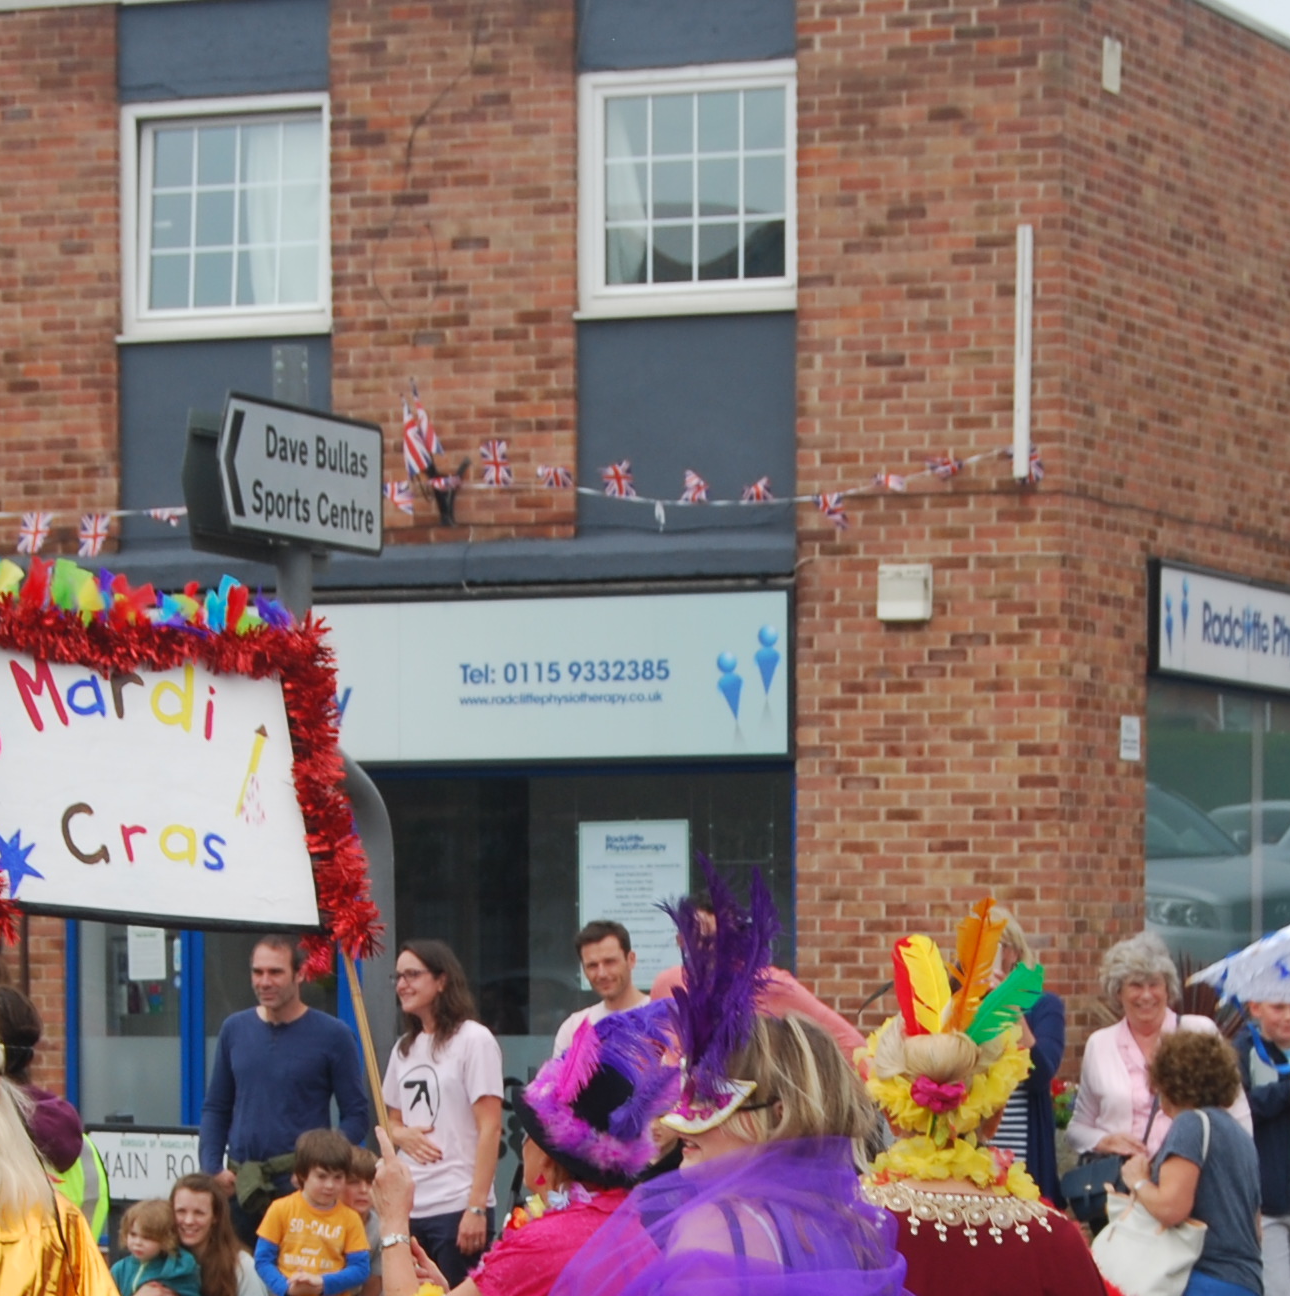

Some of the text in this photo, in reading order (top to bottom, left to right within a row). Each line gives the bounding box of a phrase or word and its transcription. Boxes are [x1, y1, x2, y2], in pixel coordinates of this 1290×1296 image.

[265, 423, 369, 479] Dave Bullas
[251, 478, 375, 535] Sports Centre
[1202, 600, 1270, 654] Radcliffe
[9, 656, 216, 741] Mardi
[459, 689, 663, 707] www.radcliffephysiotherapy.co.uk
[460, 659, 671, 685] Tel: 0115 9332385
